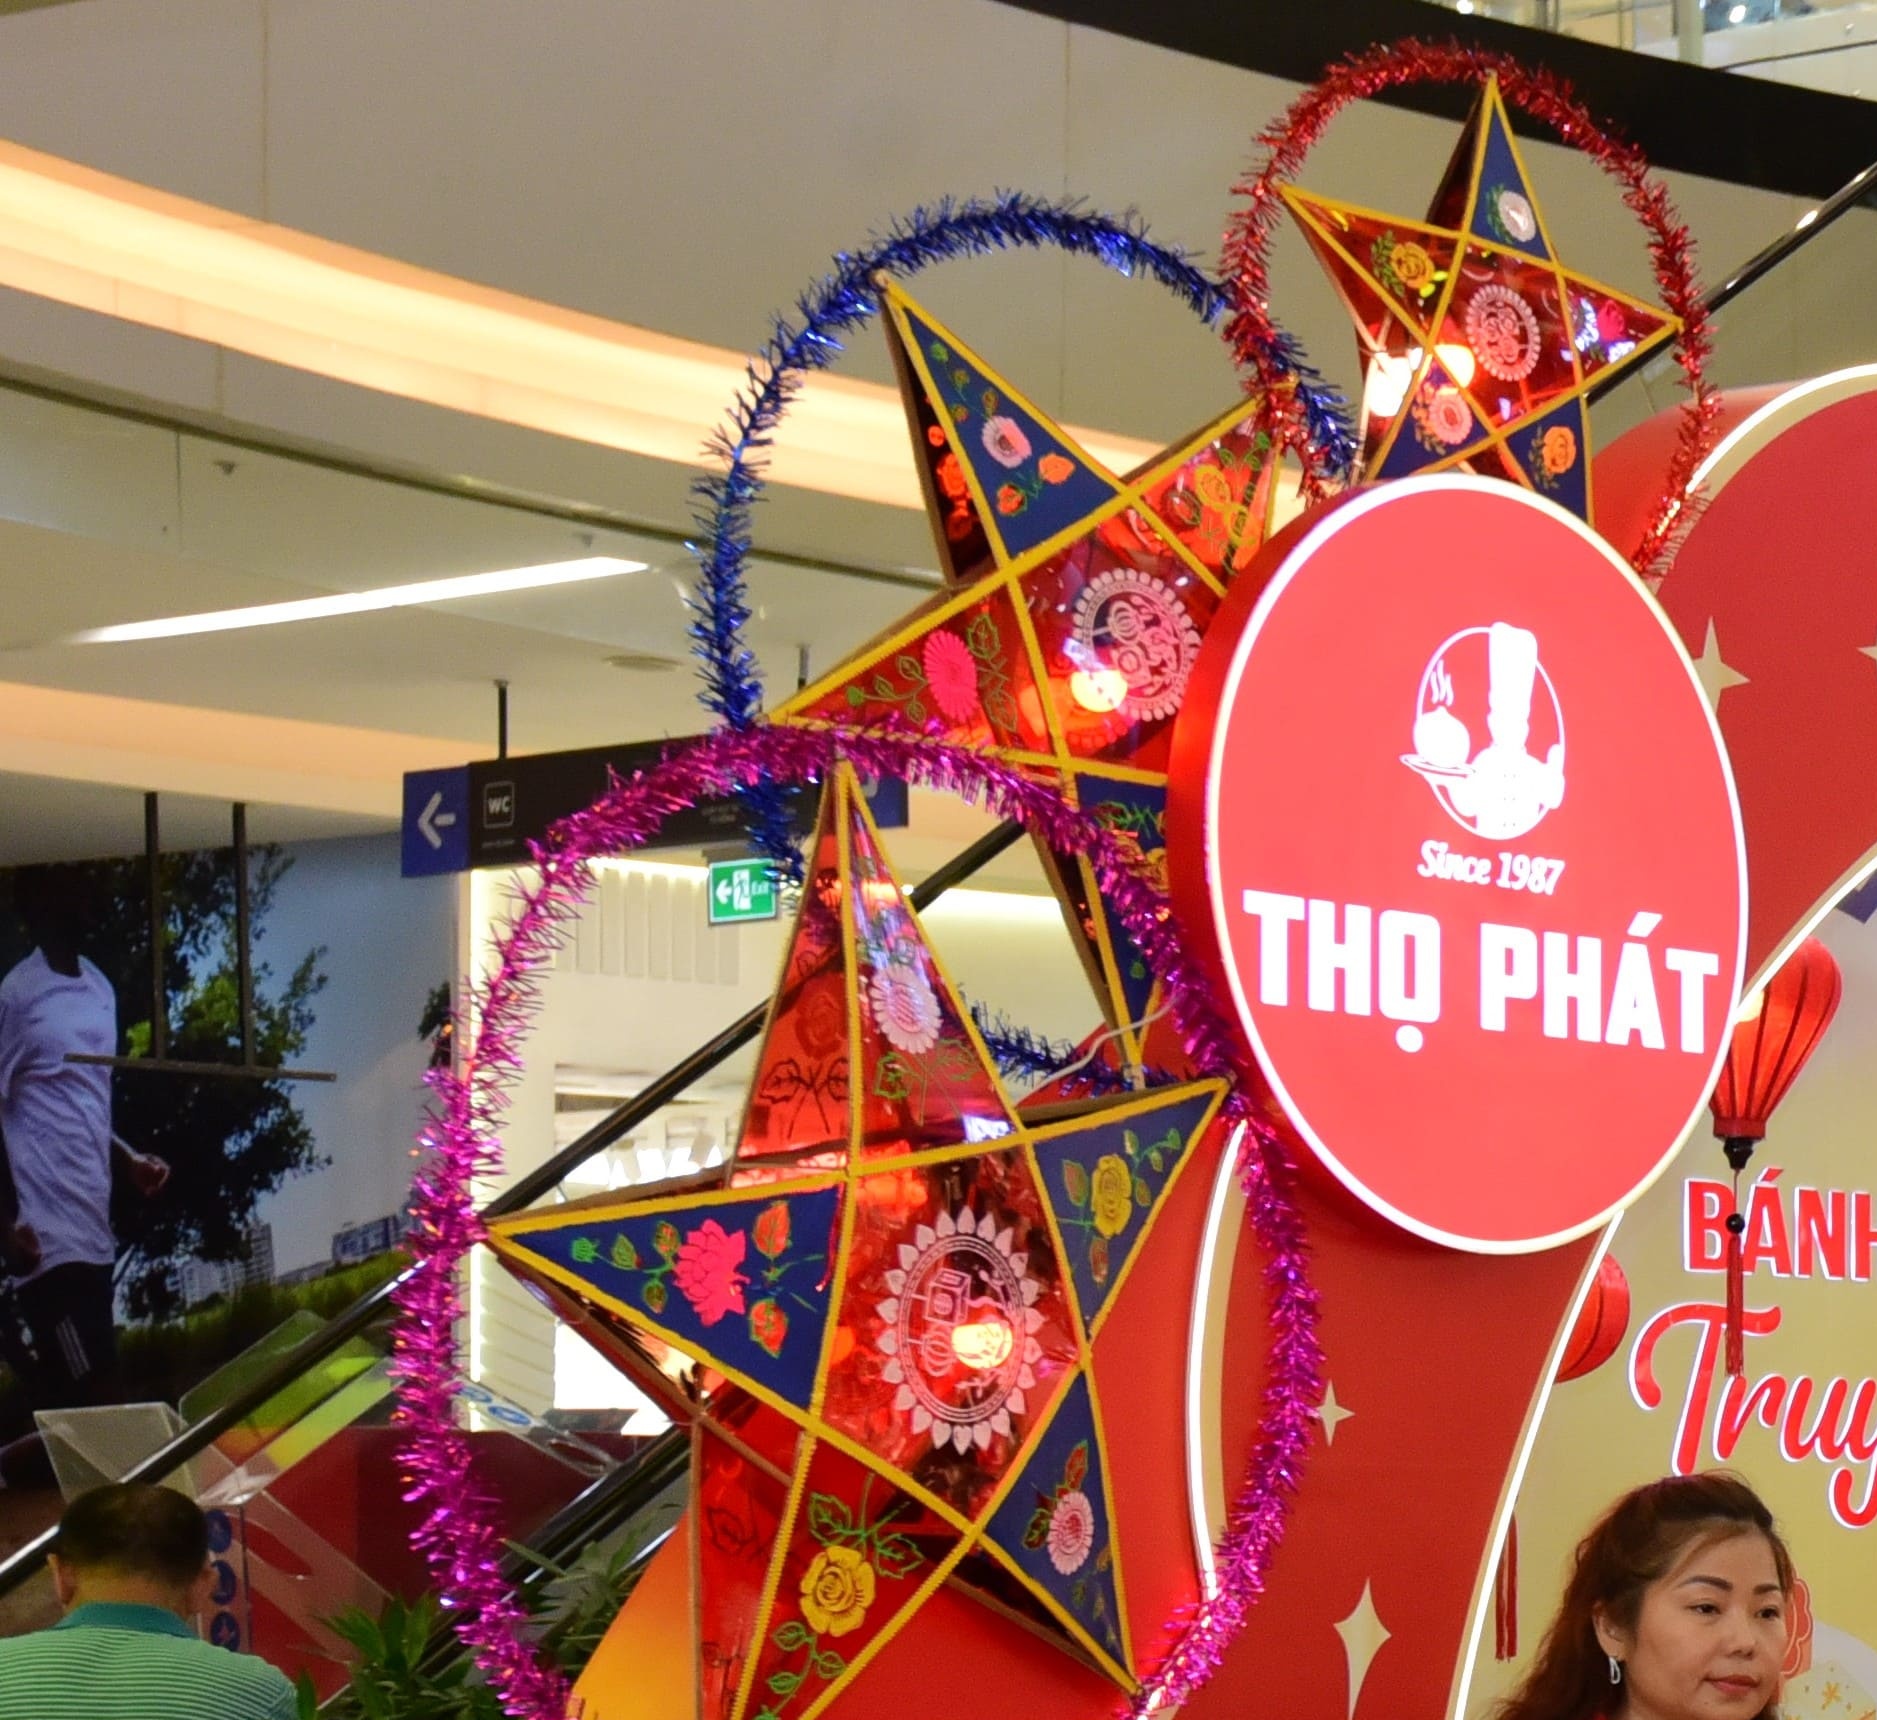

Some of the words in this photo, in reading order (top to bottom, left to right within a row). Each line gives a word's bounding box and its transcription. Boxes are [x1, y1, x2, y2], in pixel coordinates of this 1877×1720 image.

[486, 796, 512, 814] WC
[1417, 839, 1492, 887] Since
[1495, 852, 1566, 895] 1987
[1242, 889, 1442, 1054] THỌ
[1479, 911, 1720, 1055] PHÁT
